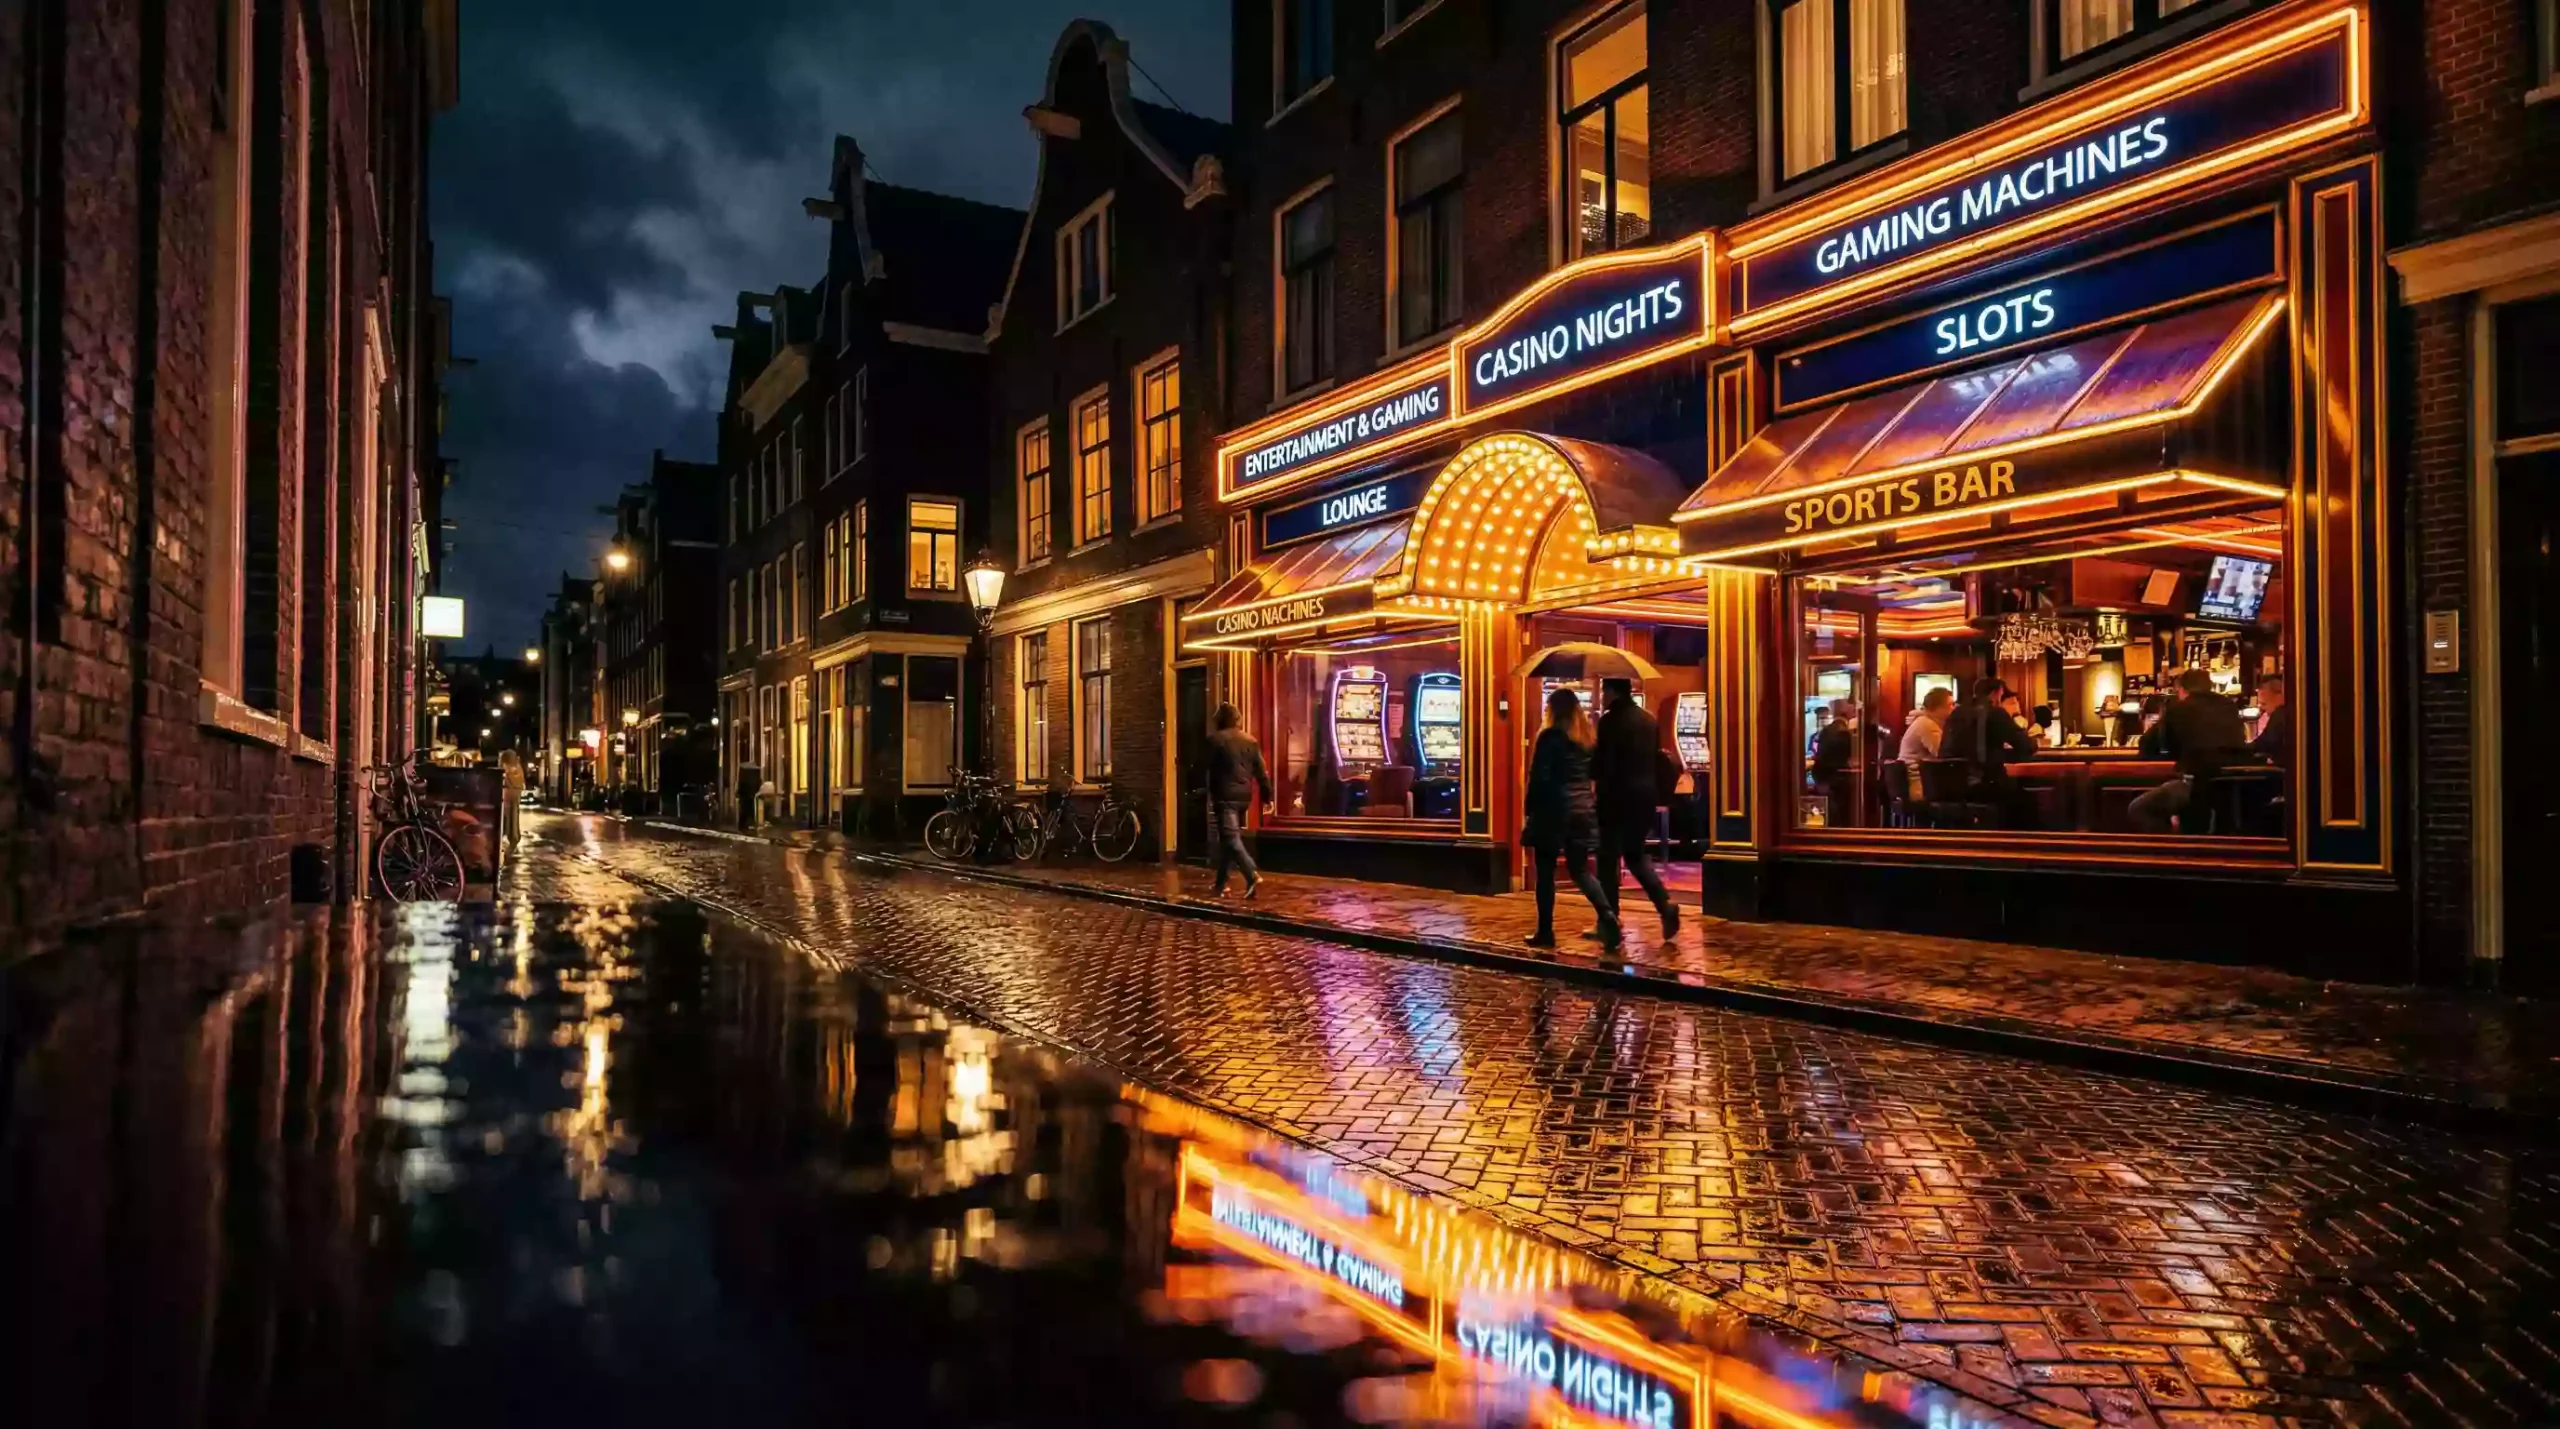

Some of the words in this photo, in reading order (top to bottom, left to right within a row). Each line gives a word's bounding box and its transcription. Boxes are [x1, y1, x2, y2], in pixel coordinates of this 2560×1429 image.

[1815, 197, 1952, 275] GAMING
[1960, 117, 2169, 225] MACHINES
[1475, 324, 1570, 387] CASINO
[1576, 280, 1683, 348] NIGHTS
[1936, 288, 2056, 356] SLOTS
[1245, 417, 1356, 476] ENTERTAINMENT
[1357, 413, 1370, 438] &
[1371, 387, 1439, 431] GAMING
[1323, 486, 1387, 525] LOUNGE
[1784, 479, 1921, 534] SPORTS
[1933, 460, 2016, 507] BAR
[1216, 610, 1259, 634] CASINO
[1262, 597, 1325, 626] NACHINES
